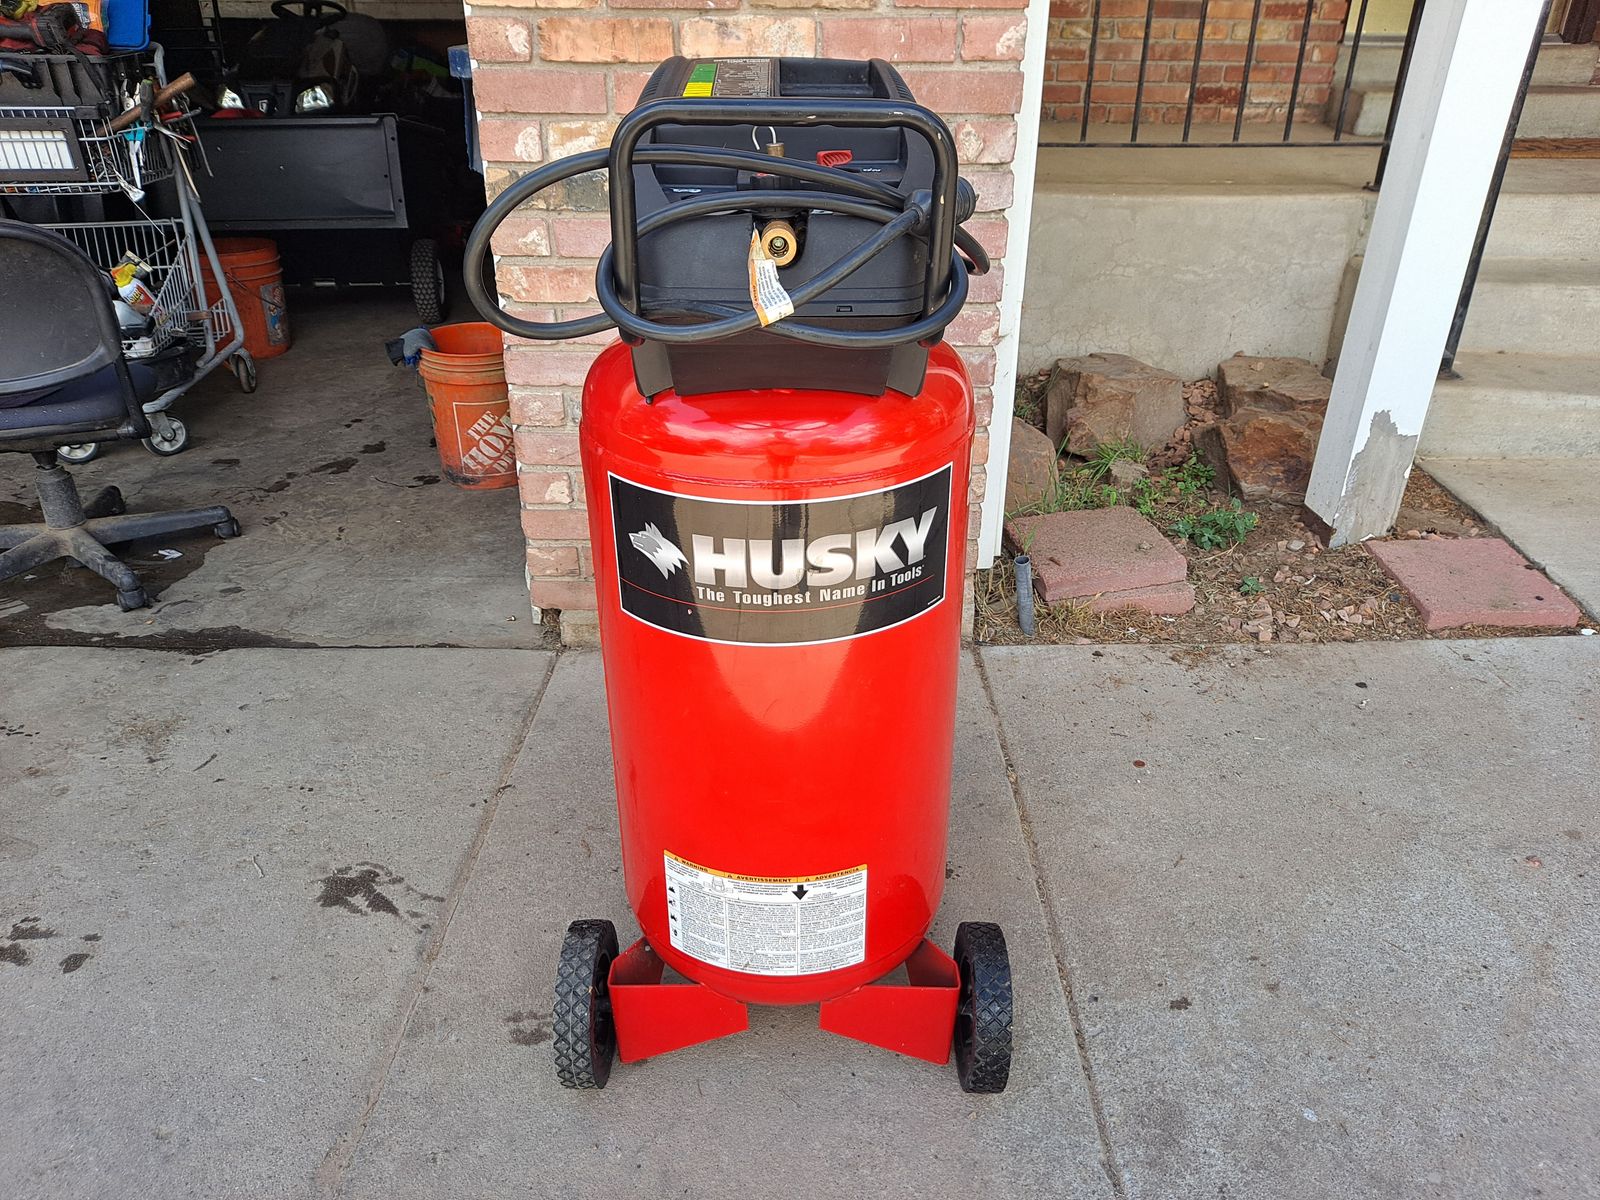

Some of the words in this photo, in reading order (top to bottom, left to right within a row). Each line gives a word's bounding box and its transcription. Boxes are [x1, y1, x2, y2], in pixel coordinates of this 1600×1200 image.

[466, 410, 498, 440] THE
[463, 408, 514, 474] HOM
[691, 506, 937, 590] HUSKY
[696, 586, 725, 602] The
[733, 590, 811, 607] Toughest
[819, 584, 866, 602] Name
[871, 579, 886, 593] In
[889, 565, 923, 587] Tools
[681, 859, 709, 873] WARNING
[736, 874, 792, 883] AVERTISSEMENT
[814, 867, 860, 880] ADVERTENCIA
